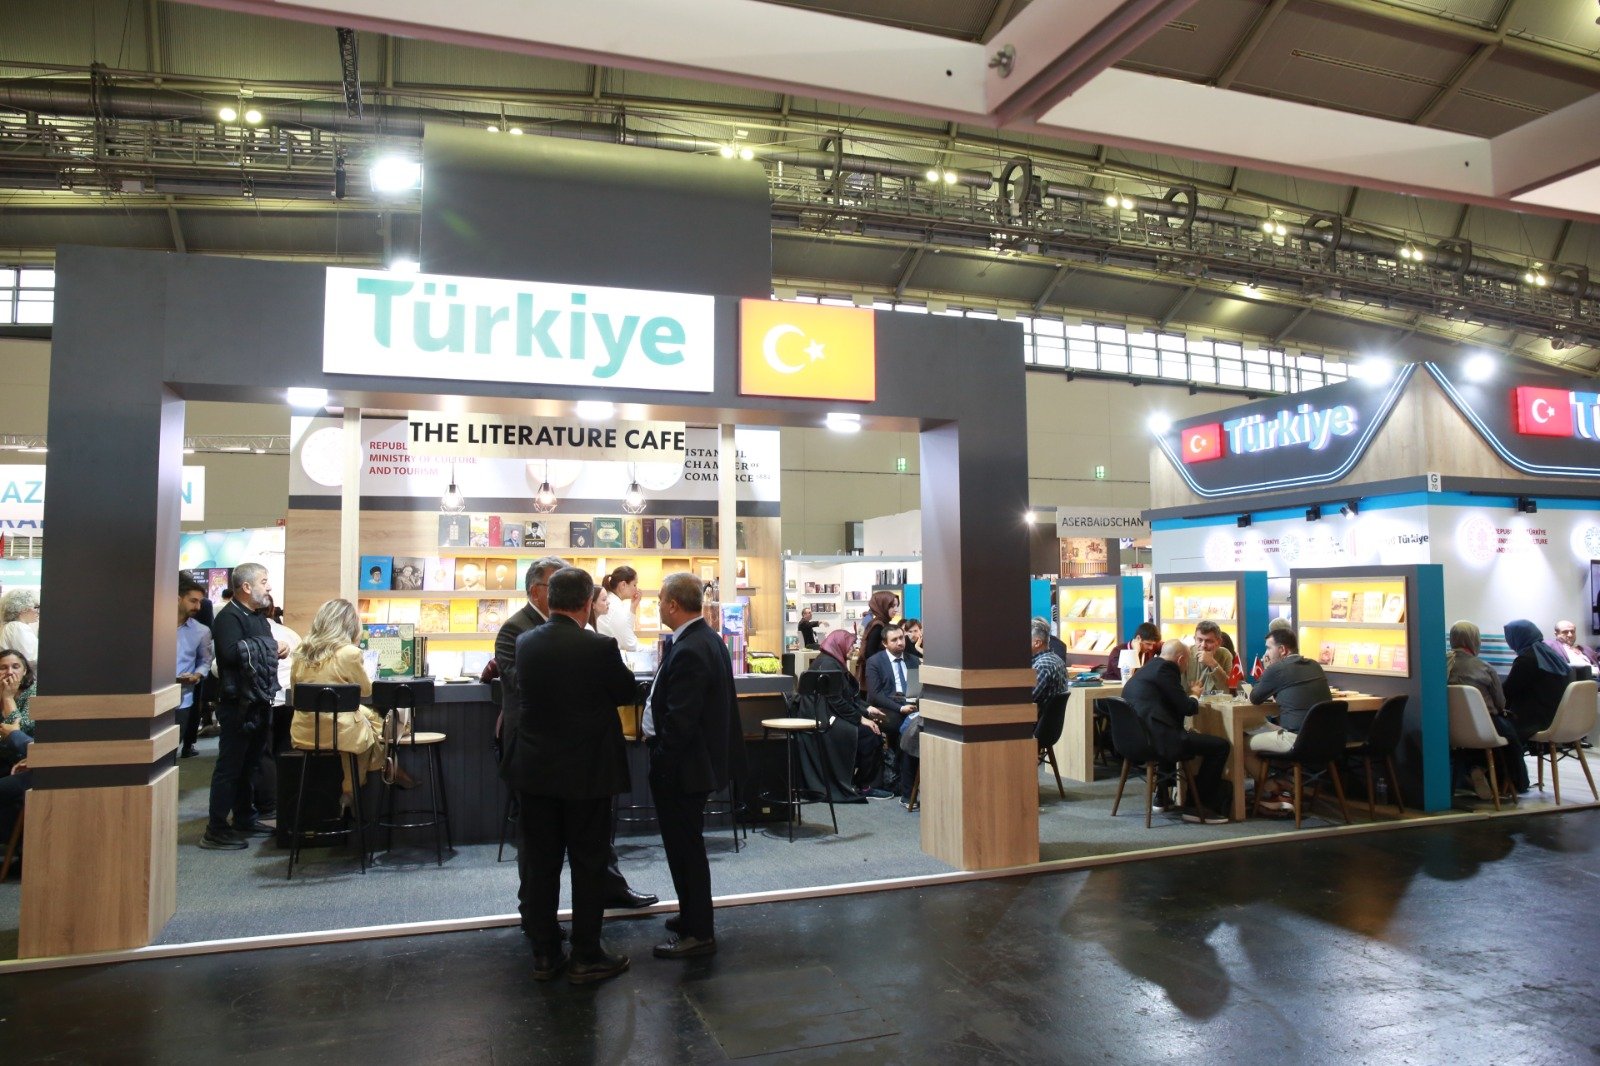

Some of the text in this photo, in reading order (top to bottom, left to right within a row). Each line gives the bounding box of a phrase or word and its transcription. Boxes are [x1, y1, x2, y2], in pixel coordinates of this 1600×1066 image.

[357, 278, 686, 378] Türkiye
[1223, 403, 1355, 455] Türkiye
[409, 421, 685, 451] THE LITERATURE CAFE
[369, 441, 408, 450] REPUBL
[369, 454, 416, 463] MINISTRY
[369, 466, 439, 476] AND TOURISM
[1431, 474, 1438, 483] G
